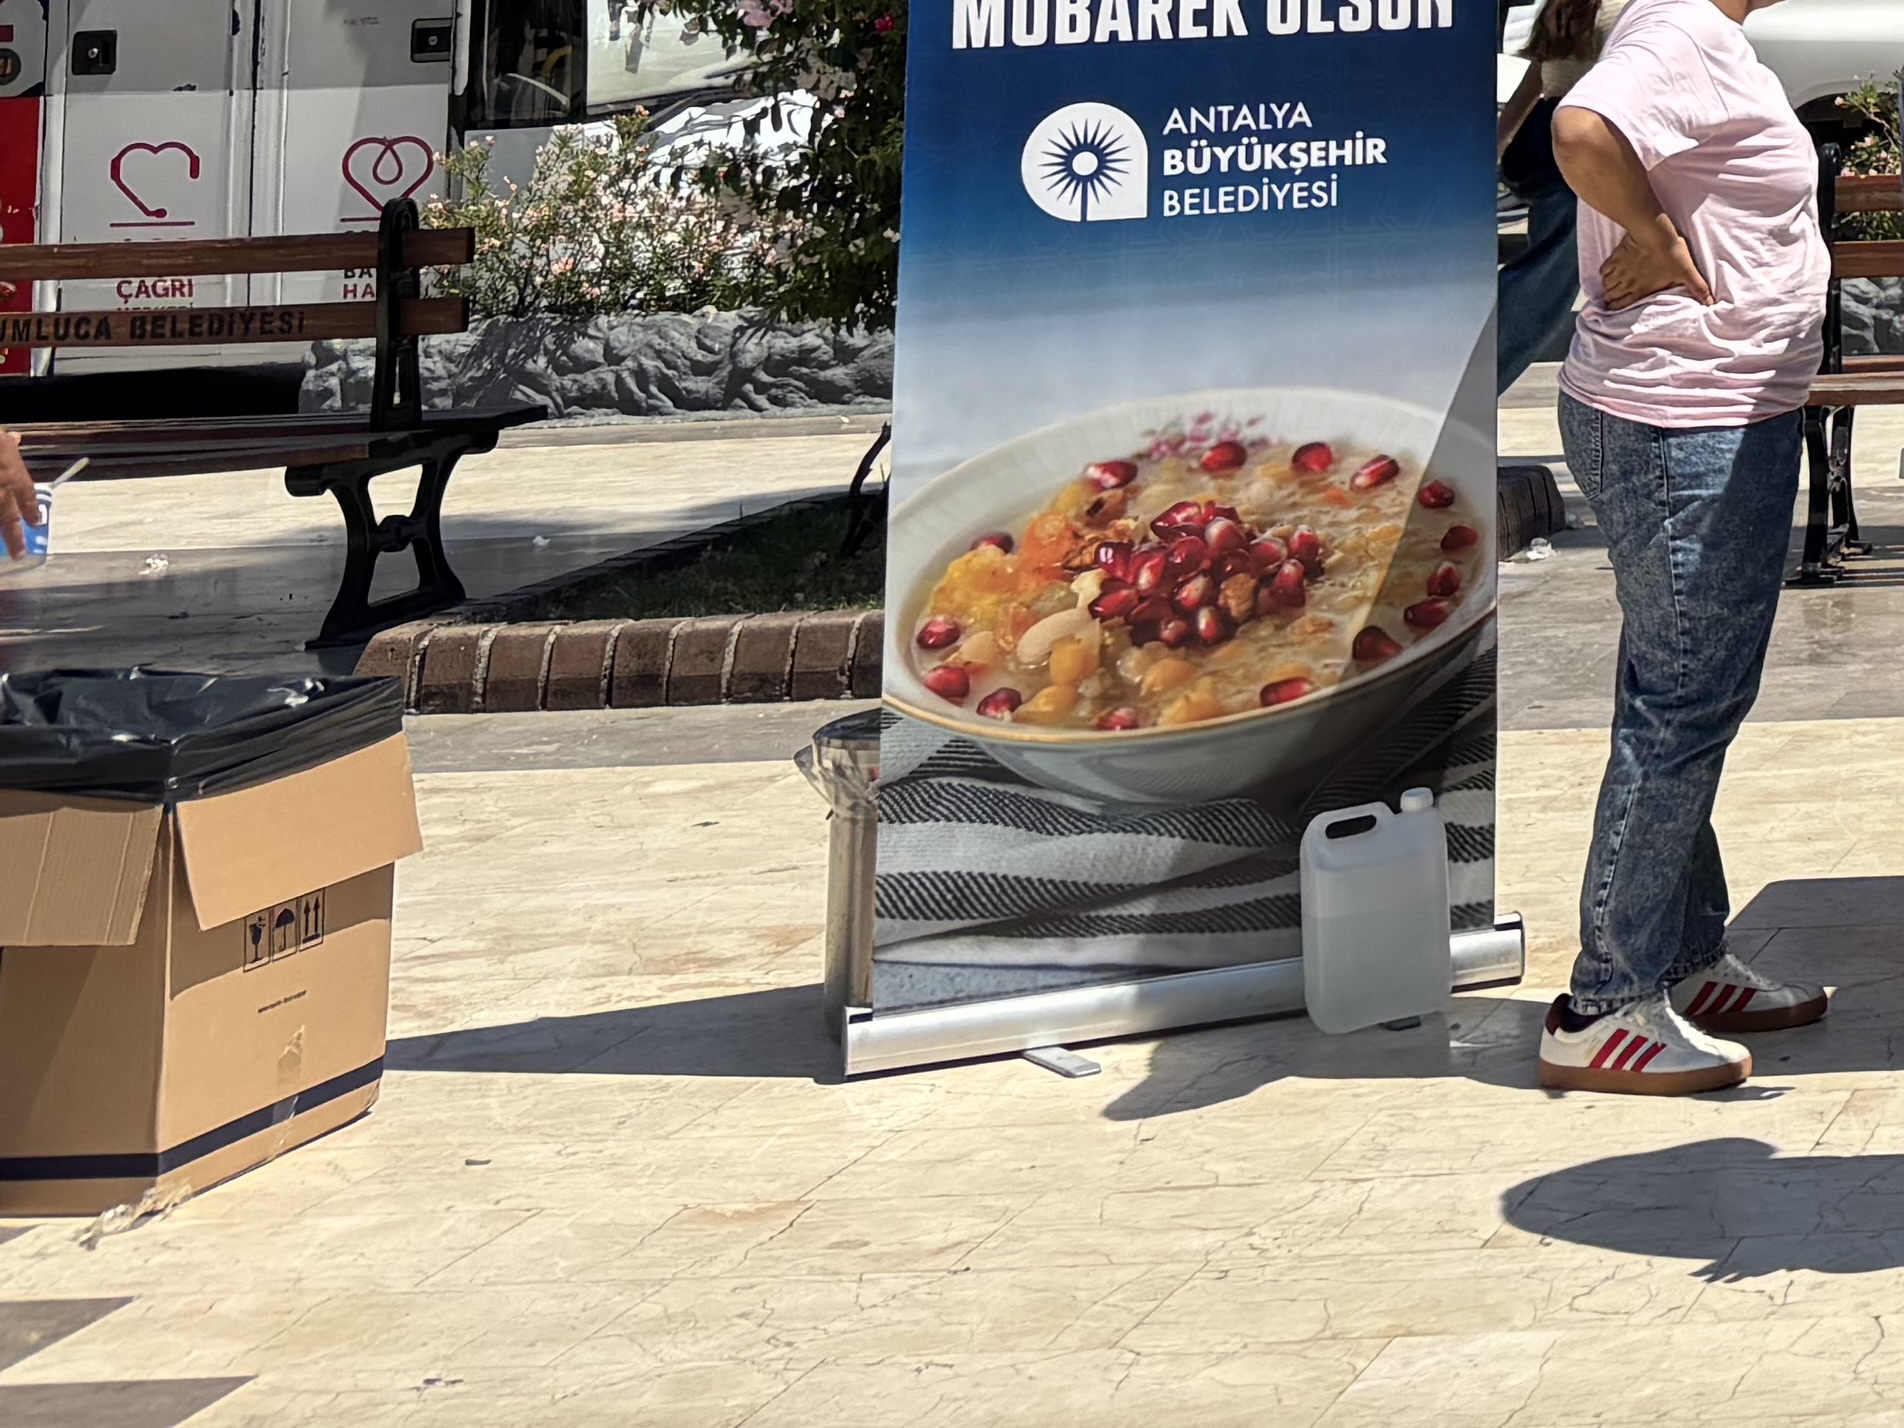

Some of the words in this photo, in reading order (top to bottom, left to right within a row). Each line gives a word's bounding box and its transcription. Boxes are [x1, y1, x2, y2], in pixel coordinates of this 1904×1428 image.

[1162, 101, 1313, 136] ANTALYA
[1162, 128, 1388, 177] BÜYÜKŞEHİR
[1162, 176, 1338, 219] BELEDİYESİ
